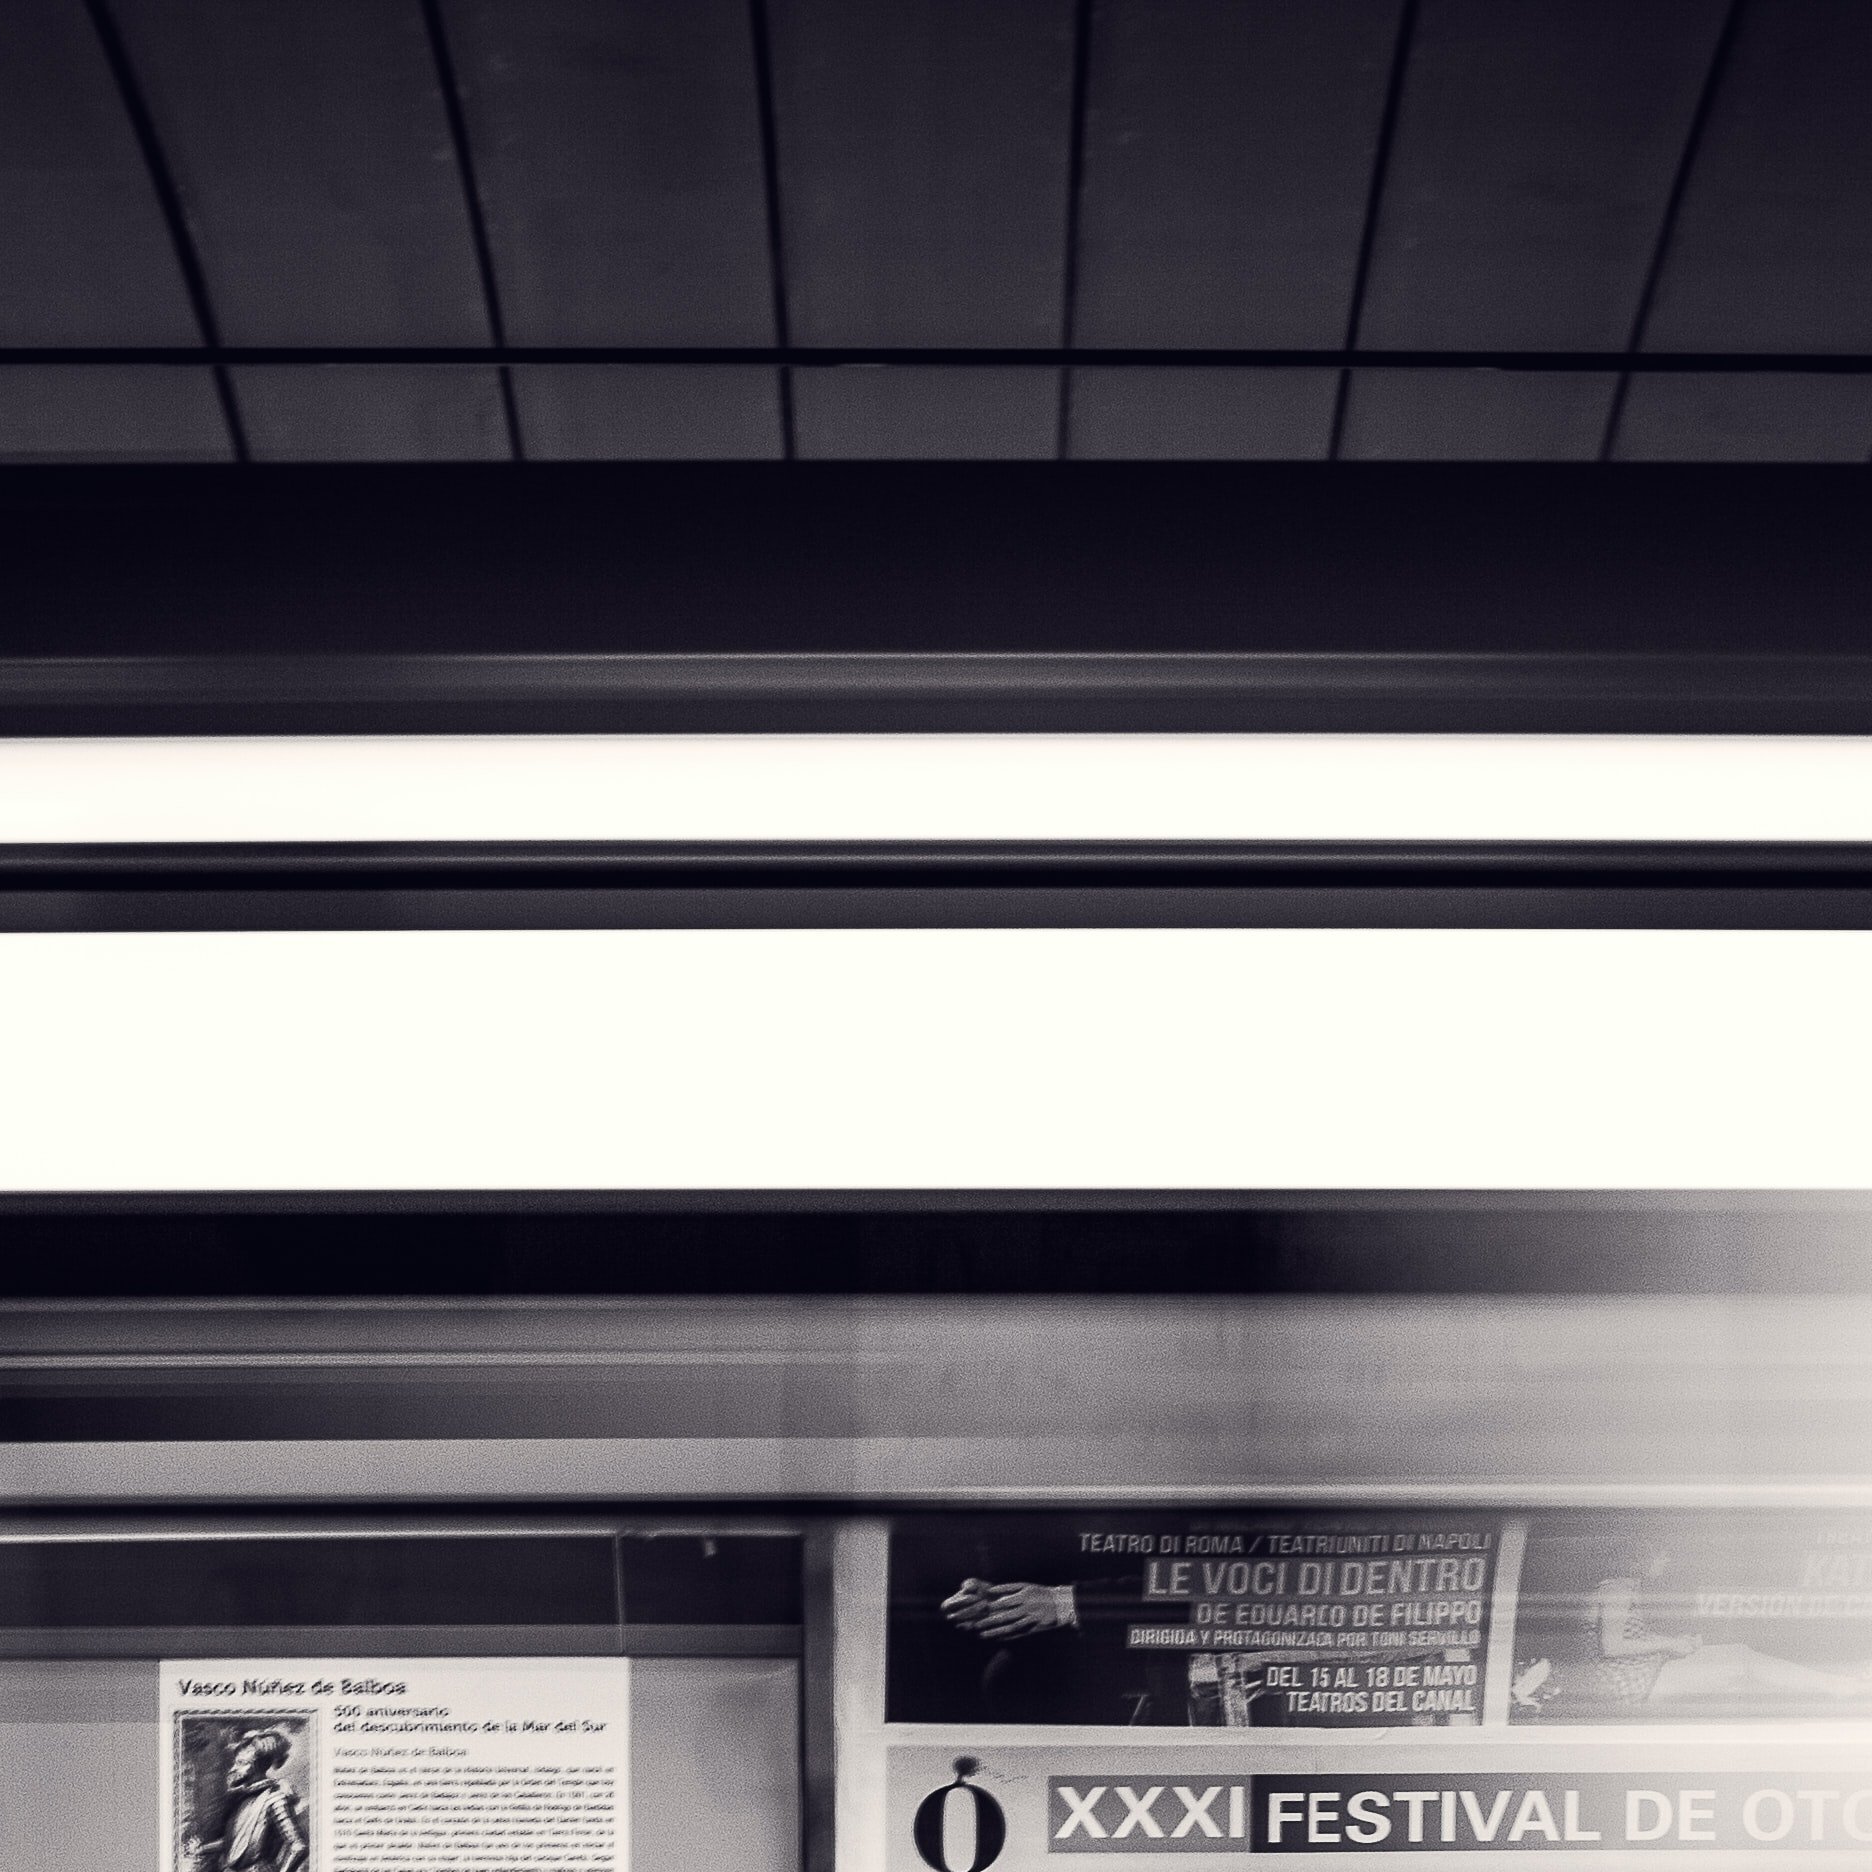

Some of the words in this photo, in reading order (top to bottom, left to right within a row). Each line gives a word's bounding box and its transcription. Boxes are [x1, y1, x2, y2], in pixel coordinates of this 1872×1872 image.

[1079, 1533, 1153, 1554] TEATRO
[1159, 1535, 1179, 1554] DI
[1185, 1535, 1243, 1554] ROMA
[1418, 1532, 1492, 1551] NAPOLI
[1148, 1561, 1193, 1595] LE
[1202, 1561, 1288, 1595] VOCI
[1297, 1561, 1335, 1595] DI
[1340, 1558, 1486, 1596] DENTRO
[1196, 1603, 1230, 1625] DE
[1235, 1604, 1346, 1627] EDUARDO
[1351, 1603, 1385, 1626] DE
[1391, 1601, 1482, 1626] FILIPPO
[1129, 1628, 1196, 1646] DIRIGIDA
[1200, 1629, 1211, 1646] Y
[1213, 1630, 1332, 1647] PROTAGONIZADA
[1337, 1631, 1368, 1647] POR
[177, 1677, 236, 1697] Vasco
[310, 1678, 335, 1697] de
[340, 1677, 407, 1697] Balboa
[1266, 1666, 1305, 1688] DEL
[1311, 1666, 1330, 1688] 15
[1334, 1666, 1360, 1688] AL
[1366, 1666, 1390, 1688] 18
[1393, 1665, 1420, 1687] DE
[1422, 1664, 1478, 1687] MAYO
[333, 1703, 362, 1717] 500
[364, 1704, 450, 1717] aniversario
[1286, 1690, 1369, 1713] TEATROS
[1372, 1690, 1408, 1712] DEL
[1411, 1689, 1477, 1712] CANAL
[333, 1719, 356, 1733] del
[359, 1719, 479, 1734] descubrimiento
[481, 1719, 501, 1733] de
[505, 1719, 518, 1732] la
[522, 1719, 551, 1733] Mar
[553, 1718, 578, 1733] del
[581, 1718, 609, 1733] Sur
[1054, 1784, 1246, 1839] XXXI
[1268, 1789, 1602, 1844] FESTIVAL
[1625, 1788, 1717, 1843] DE
